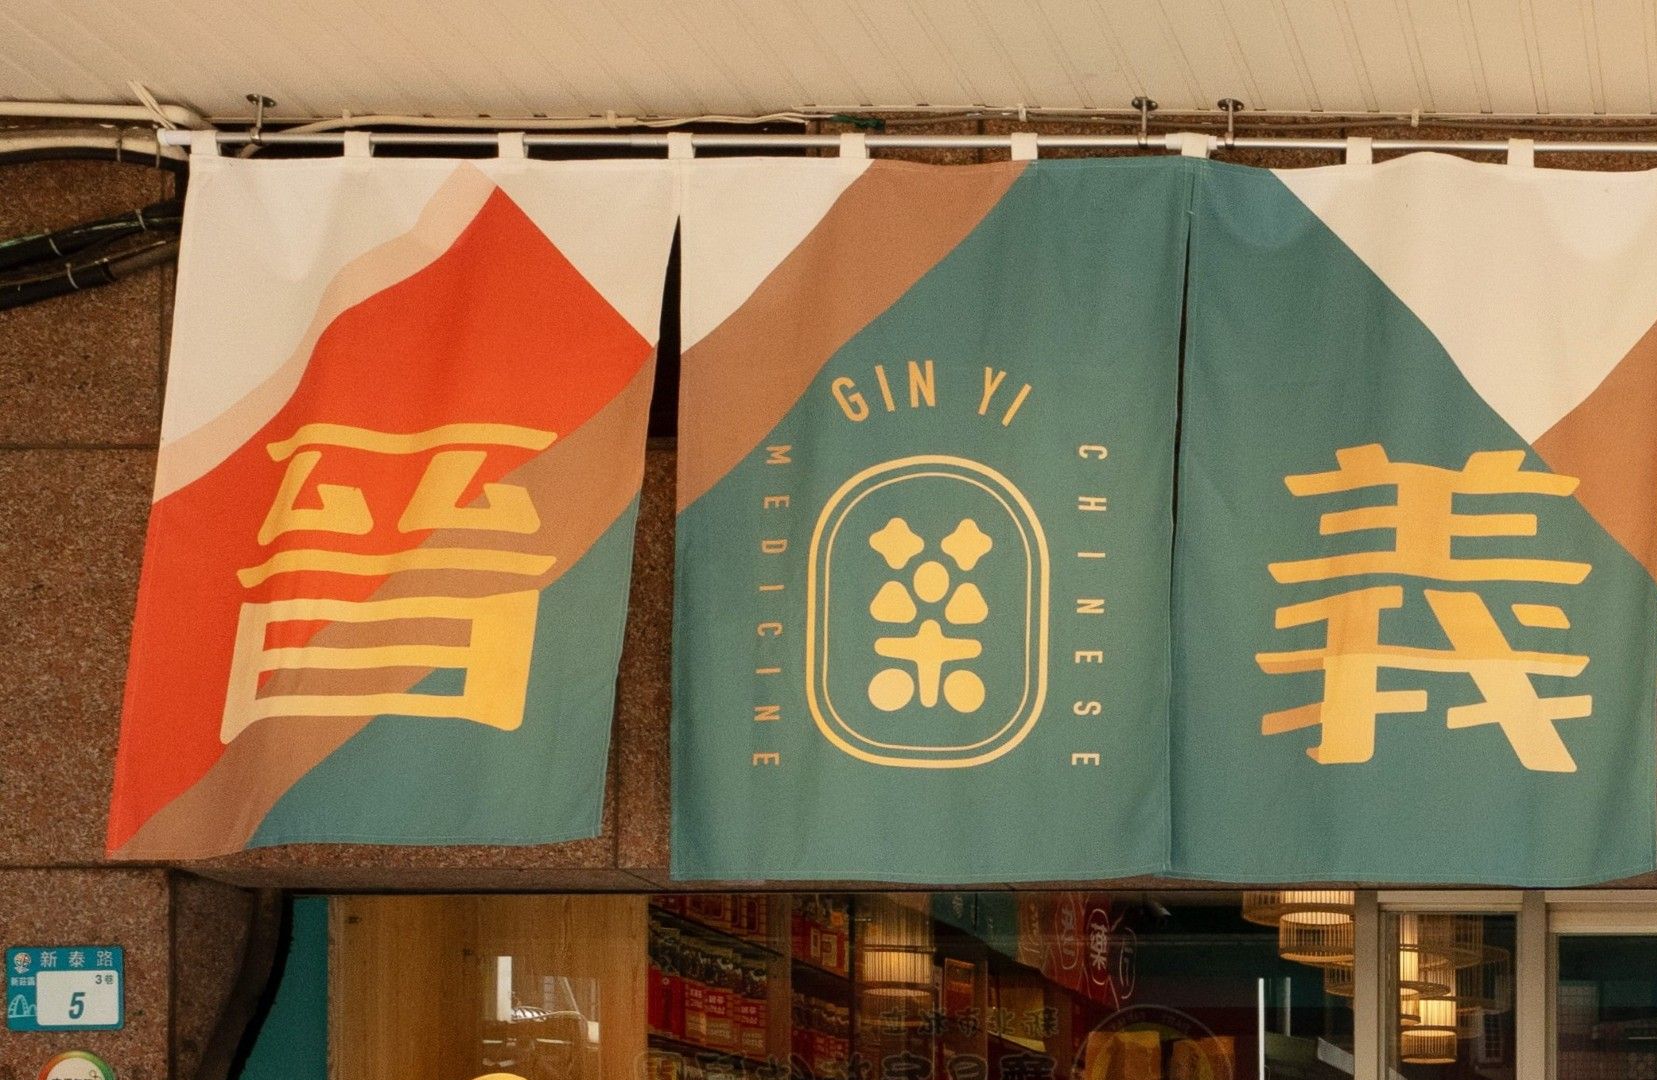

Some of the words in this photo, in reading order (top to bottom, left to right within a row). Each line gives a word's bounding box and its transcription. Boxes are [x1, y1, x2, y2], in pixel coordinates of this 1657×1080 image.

[831, 360, 938, 423] GIN
[976, 365, 1033, 428] YI
[220, 422, 559, 745] 晉
[752, 443, 795, 768] MEDICINE
[1071, 443, 1109, 767] CHINESE
[40, 950, 113, 968] 新泰路
[68, 991, 86, 1020] 5
